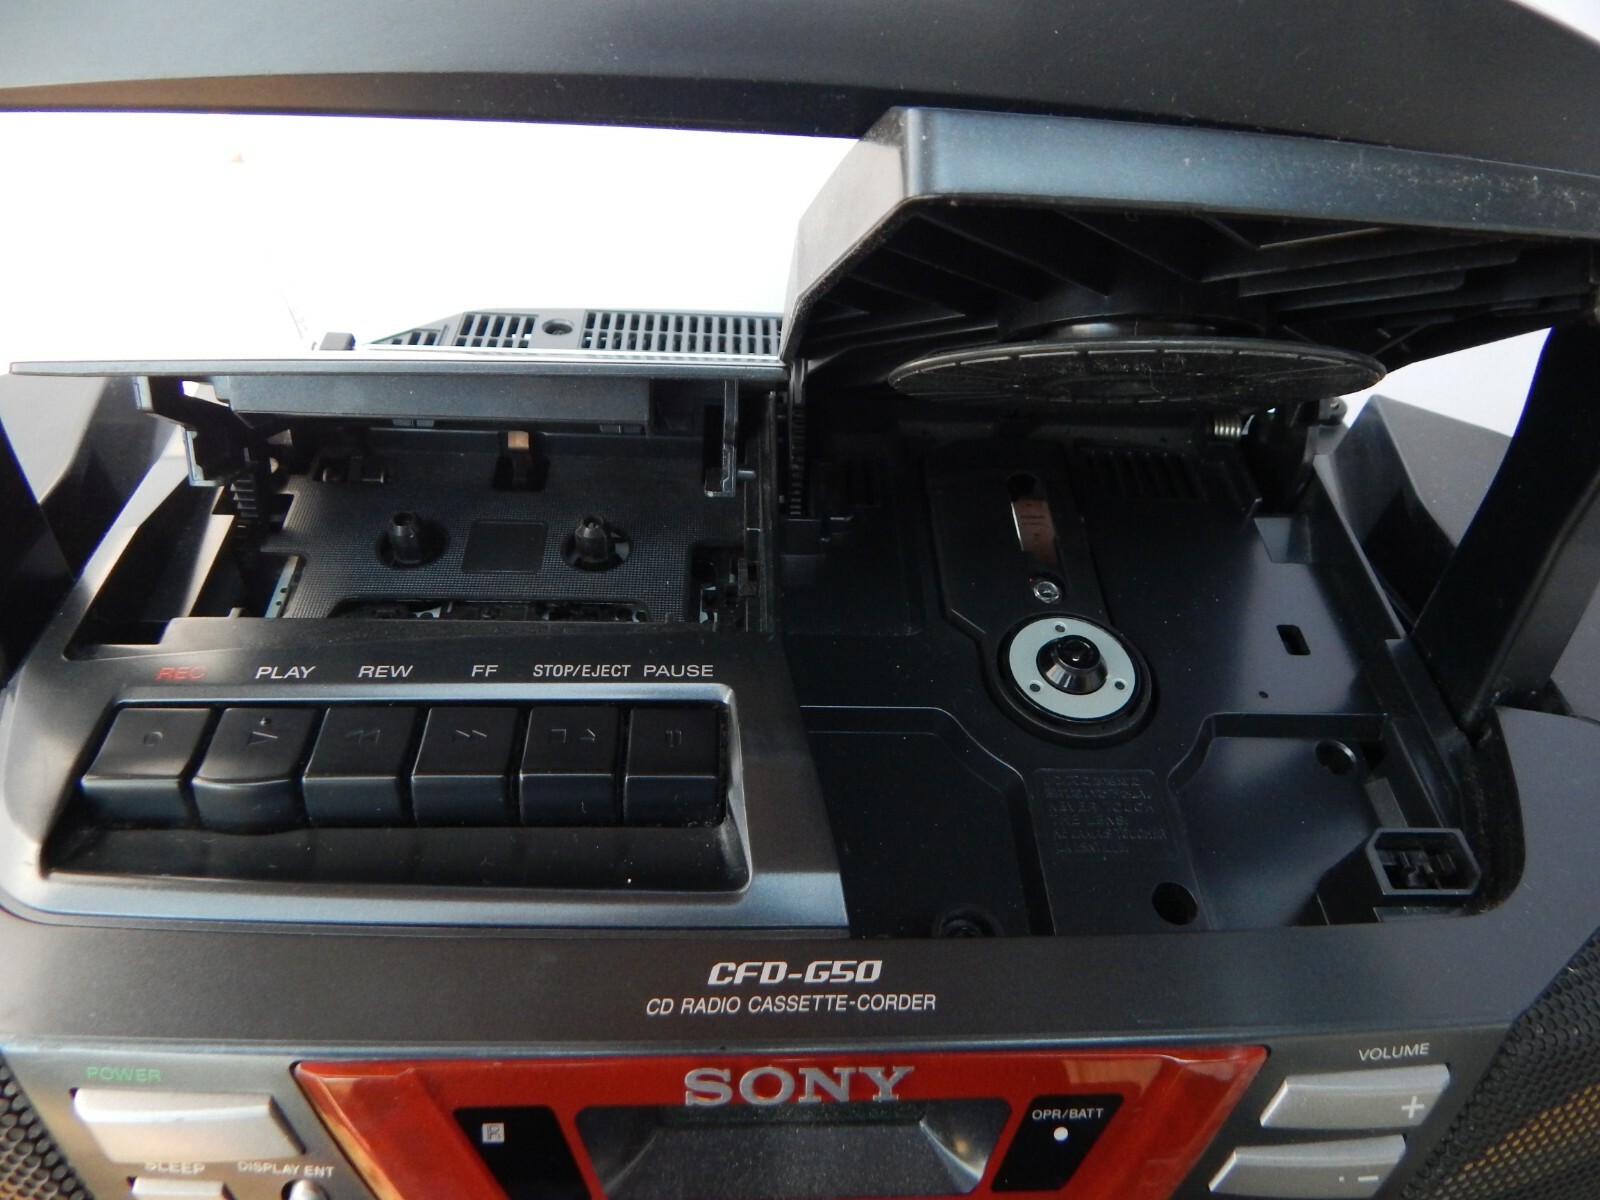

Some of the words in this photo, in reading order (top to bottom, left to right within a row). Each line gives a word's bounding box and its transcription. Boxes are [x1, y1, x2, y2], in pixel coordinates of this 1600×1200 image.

[155, 666, 208, 681] REC
[255, 666, 316, 680] PLAY
[357, 665, 414, 678] REW
[471, 664, 498, 677] FF
[532, 664, 632, 677] STOP/EJECT
[643, 664, 714, 677] PAUSE
[707, 960, 883, 986] CFD-G50
[646, 998, 674, 1016] CD
[680, 997, 742, 1014] RADIO
[748, 994, 937, 1013] CASSETTE-CORDER
[1358, 1042, 1431, 1062] VOLUME
[86, 1066, 162, 1083] POWER
[684, 1065, 915, 1106] SONY
[1031, 1107, 1105, 1121] OPR/BATT
[144, 1161, 206, 1176] SLEEP
[237, 1160, 300, 1175] DISPLAY
[303, 1164, 335, 1178] ENT
